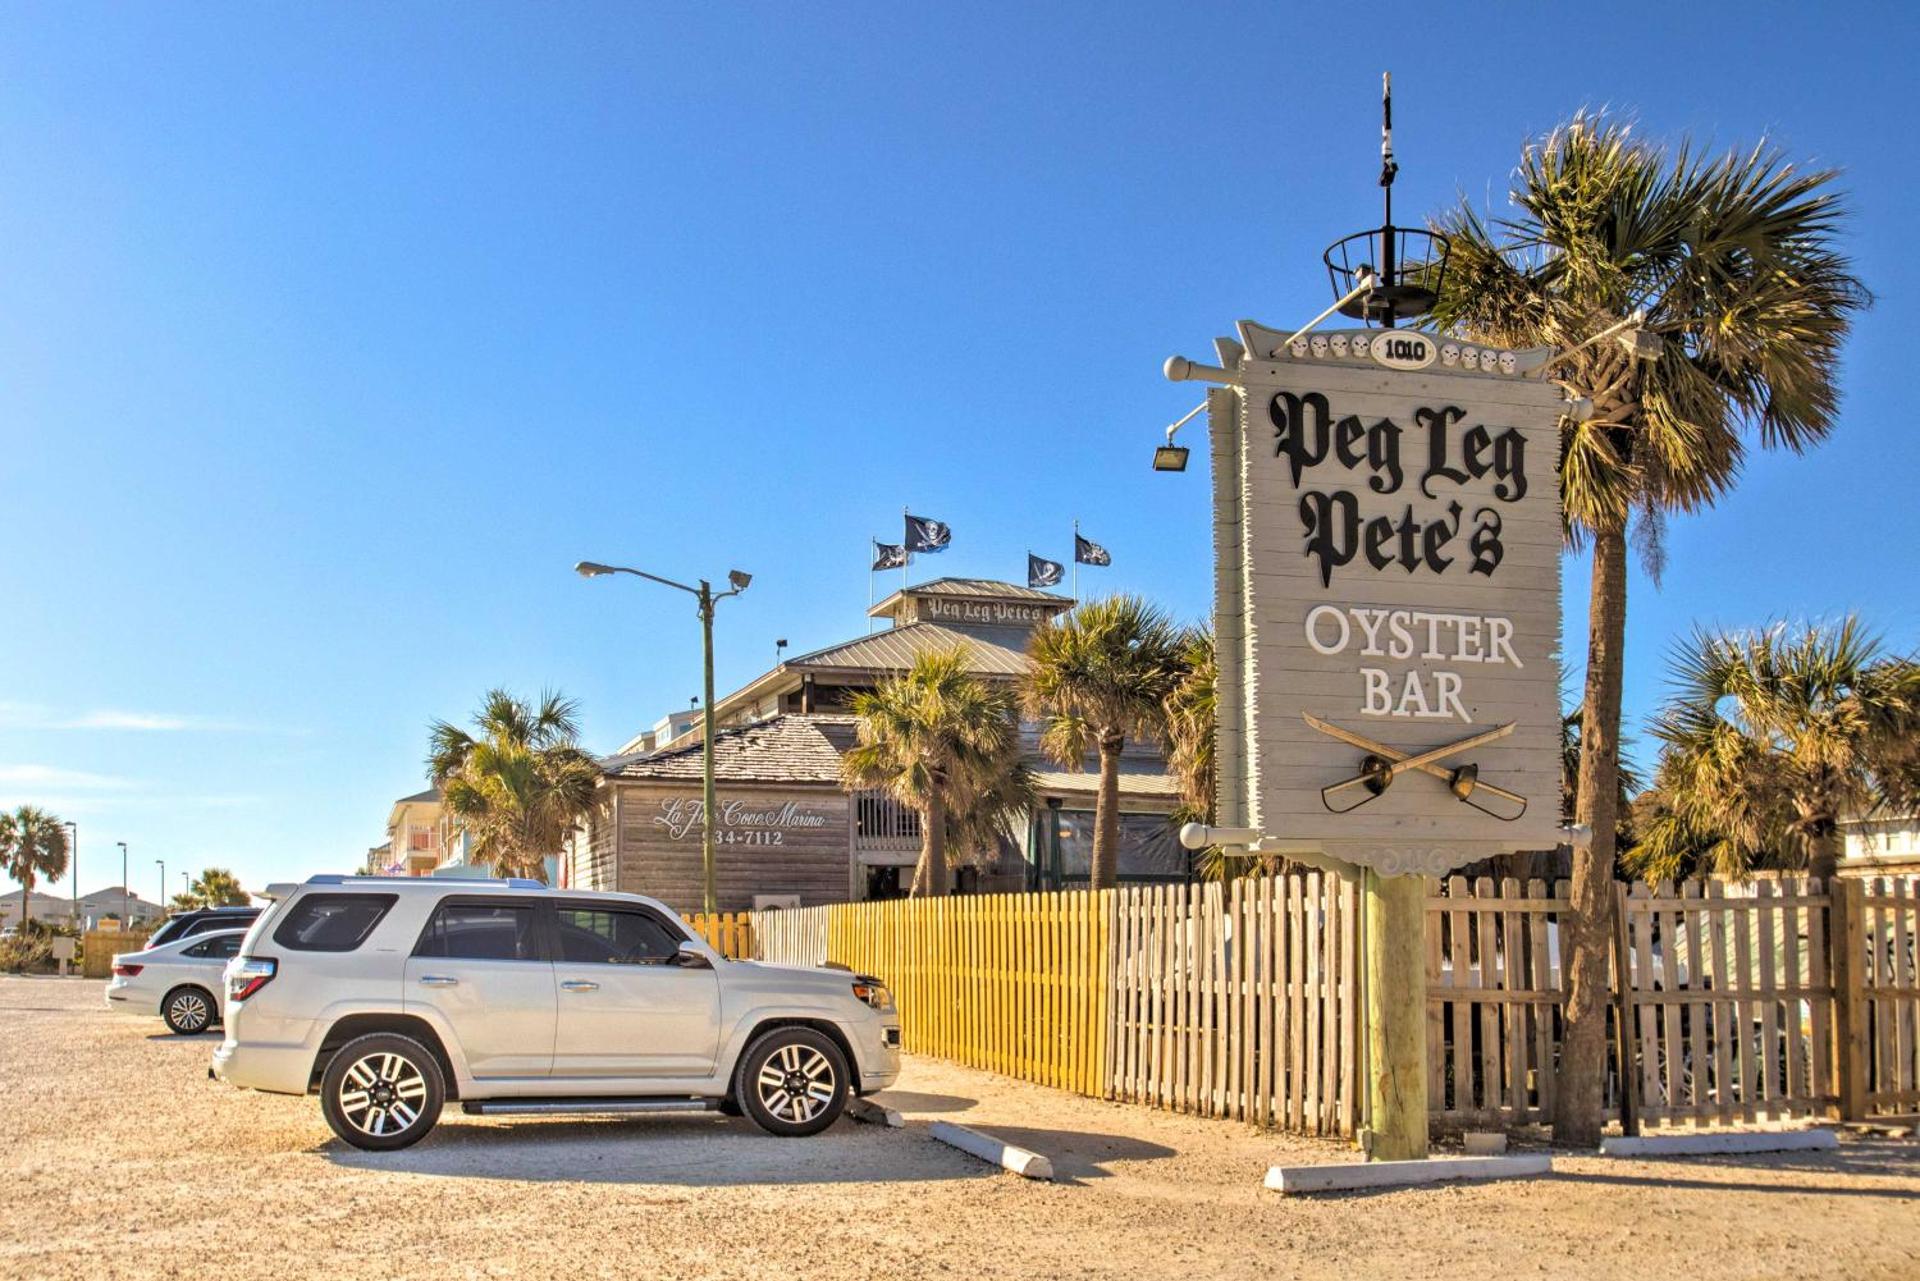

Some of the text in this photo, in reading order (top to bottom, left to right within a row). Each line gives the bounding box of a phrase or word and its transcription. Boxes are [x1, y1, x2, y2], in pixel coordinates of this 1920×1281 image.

[1386, 339, 1426, 361] 1010
[1268, 391, 1529, 501] Peg Leg
[1300, 490, 1504, 588] Pete's
[928, 599, 960, 619] Peg
[962, 601, 990, 622] Leg
[1305, 605, 1524, 669] OYSTER
[1359, 667, 1473, 723] BAR
[653, 799, 683, 833] La
[722, 799, 765, 827] Cove
[764, 800, 825, 829] Marina
[702, 830, 783, 846] 34-7112
